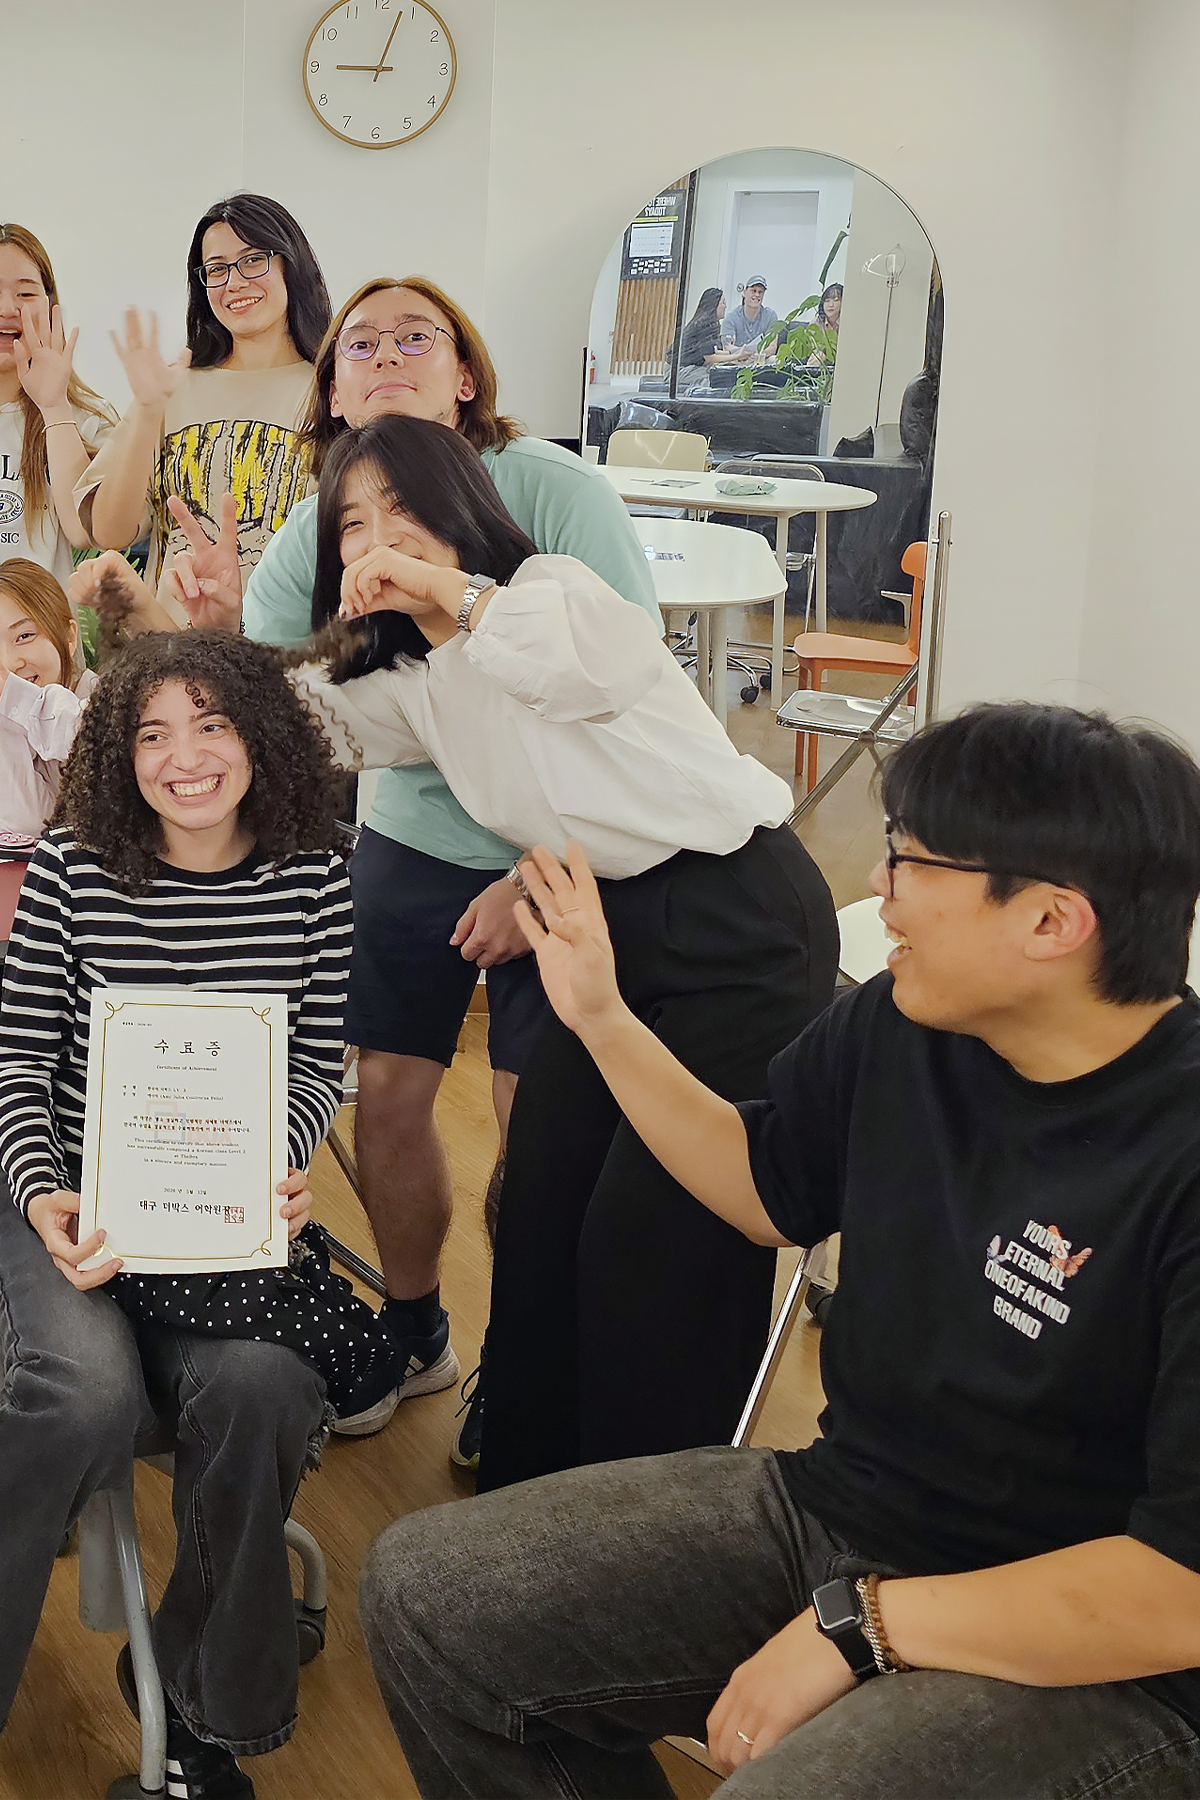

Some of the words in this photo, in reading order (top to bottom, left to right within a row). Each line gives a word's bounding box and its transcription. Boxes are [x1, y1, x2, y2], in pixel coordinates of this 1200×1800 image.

[346, 5, 359, 19] 11
[411, 6, 416, 20] 1
[322, 27, 338, 41] 10
[430, 29, 439, 43] 2
[310, 60, 320, 74] 9
[438, 62, 449, 76] 3
[318, 93, 328, 106] 8
[427, 95, 436, 109] 4
[342, 115, 352, 129] 7
[402, 116, 412, 130] 5
[371, 126, 380, 140] 6
[1022, 1219, 1072, 1260] YOURS
[1004, 1240, 1065, 1292] ETERNAL
[984, 1259, 1072, 1325] ONEOFAKIND
[992, 1294, 1043, 1340] BRAND
